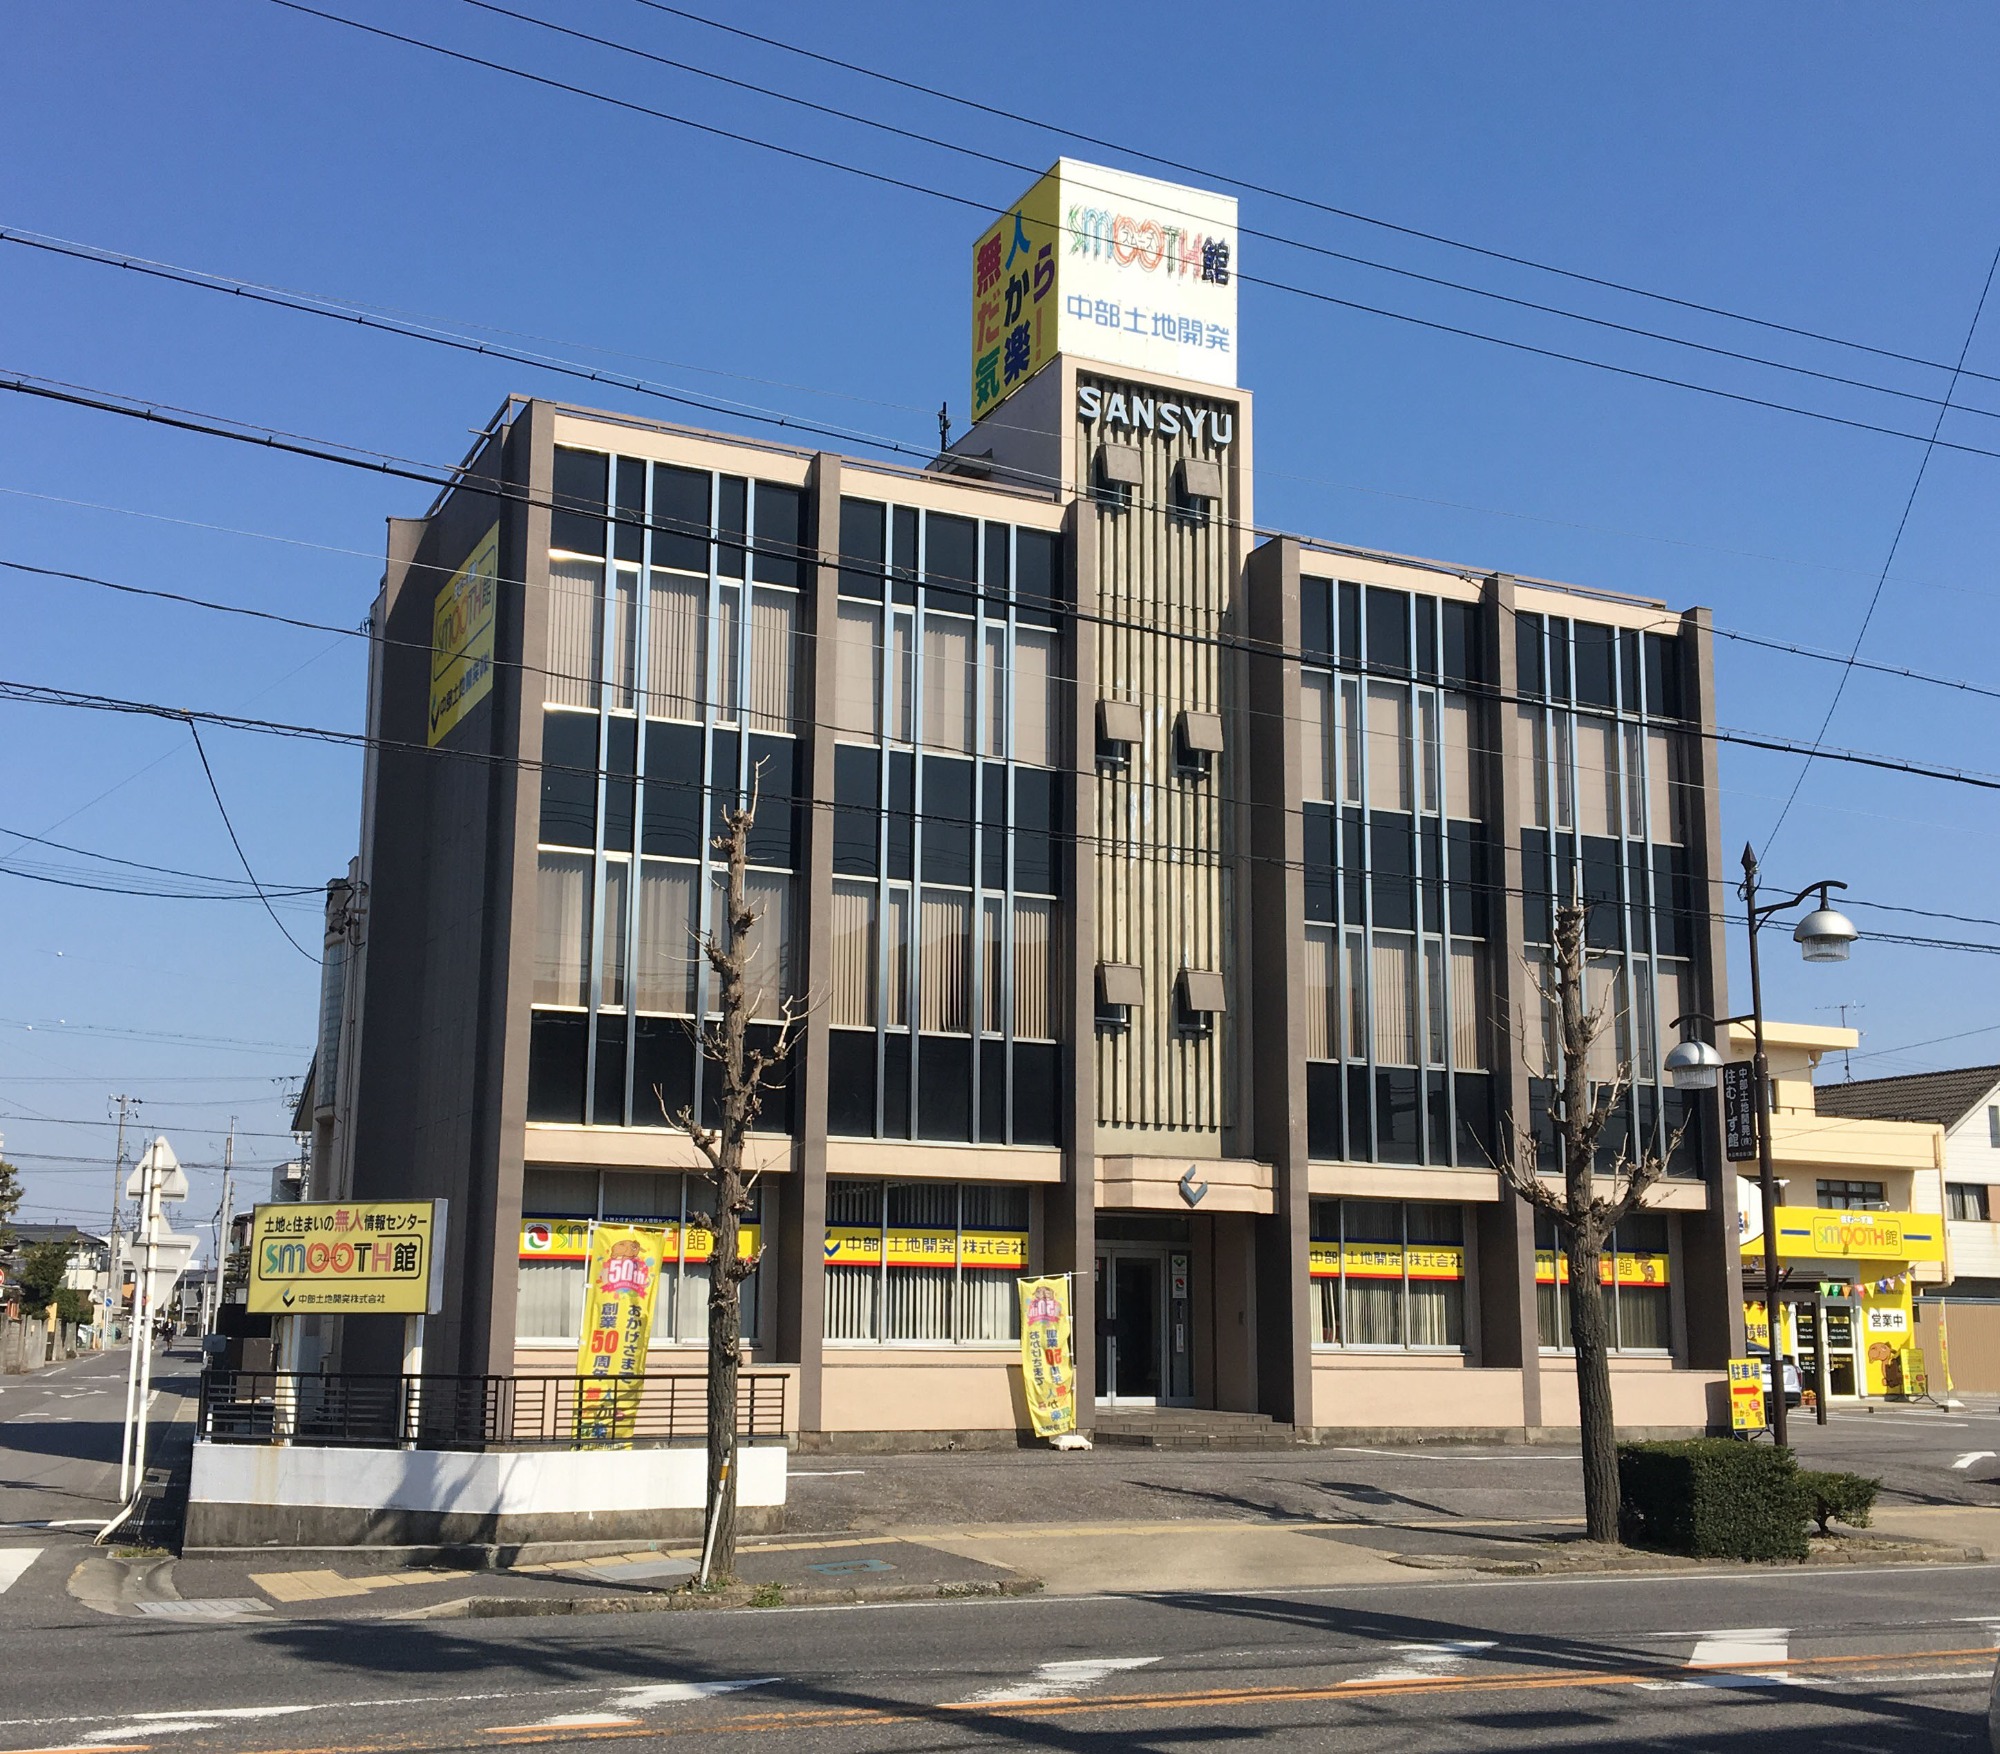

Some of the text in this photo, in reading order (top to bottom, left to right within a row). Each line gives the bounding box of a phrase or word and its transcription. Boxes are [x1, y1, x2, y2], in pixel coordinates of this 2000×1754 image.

[977, 209, 1031, 297] 無人
[976, 242, 1055, 352] だから
[1067, 294, 1230, 353] 中部土地開発
[1078, 385, 1233, 444] SANSYU
[264, 1208, 428, 1233] 土地と住まいの無人情報センター
[316, 1253, 343, 1262] スムーズ
[845, 1235, 1027, 1256] 中部土地開発株式会社
[1310, 1249, 1463, 1268] 中部土地開発株式会社
[298, 1294, 386, 1304] 中部土地開発株式会社
[1871, 1313, 1904, 1328] 営業中
[590, 1302, 619, 1382] 創業50周年
[619, 1303, 643, 1385] おかげさまで
[1731, 1363, 1761, 1380] 駐車場
